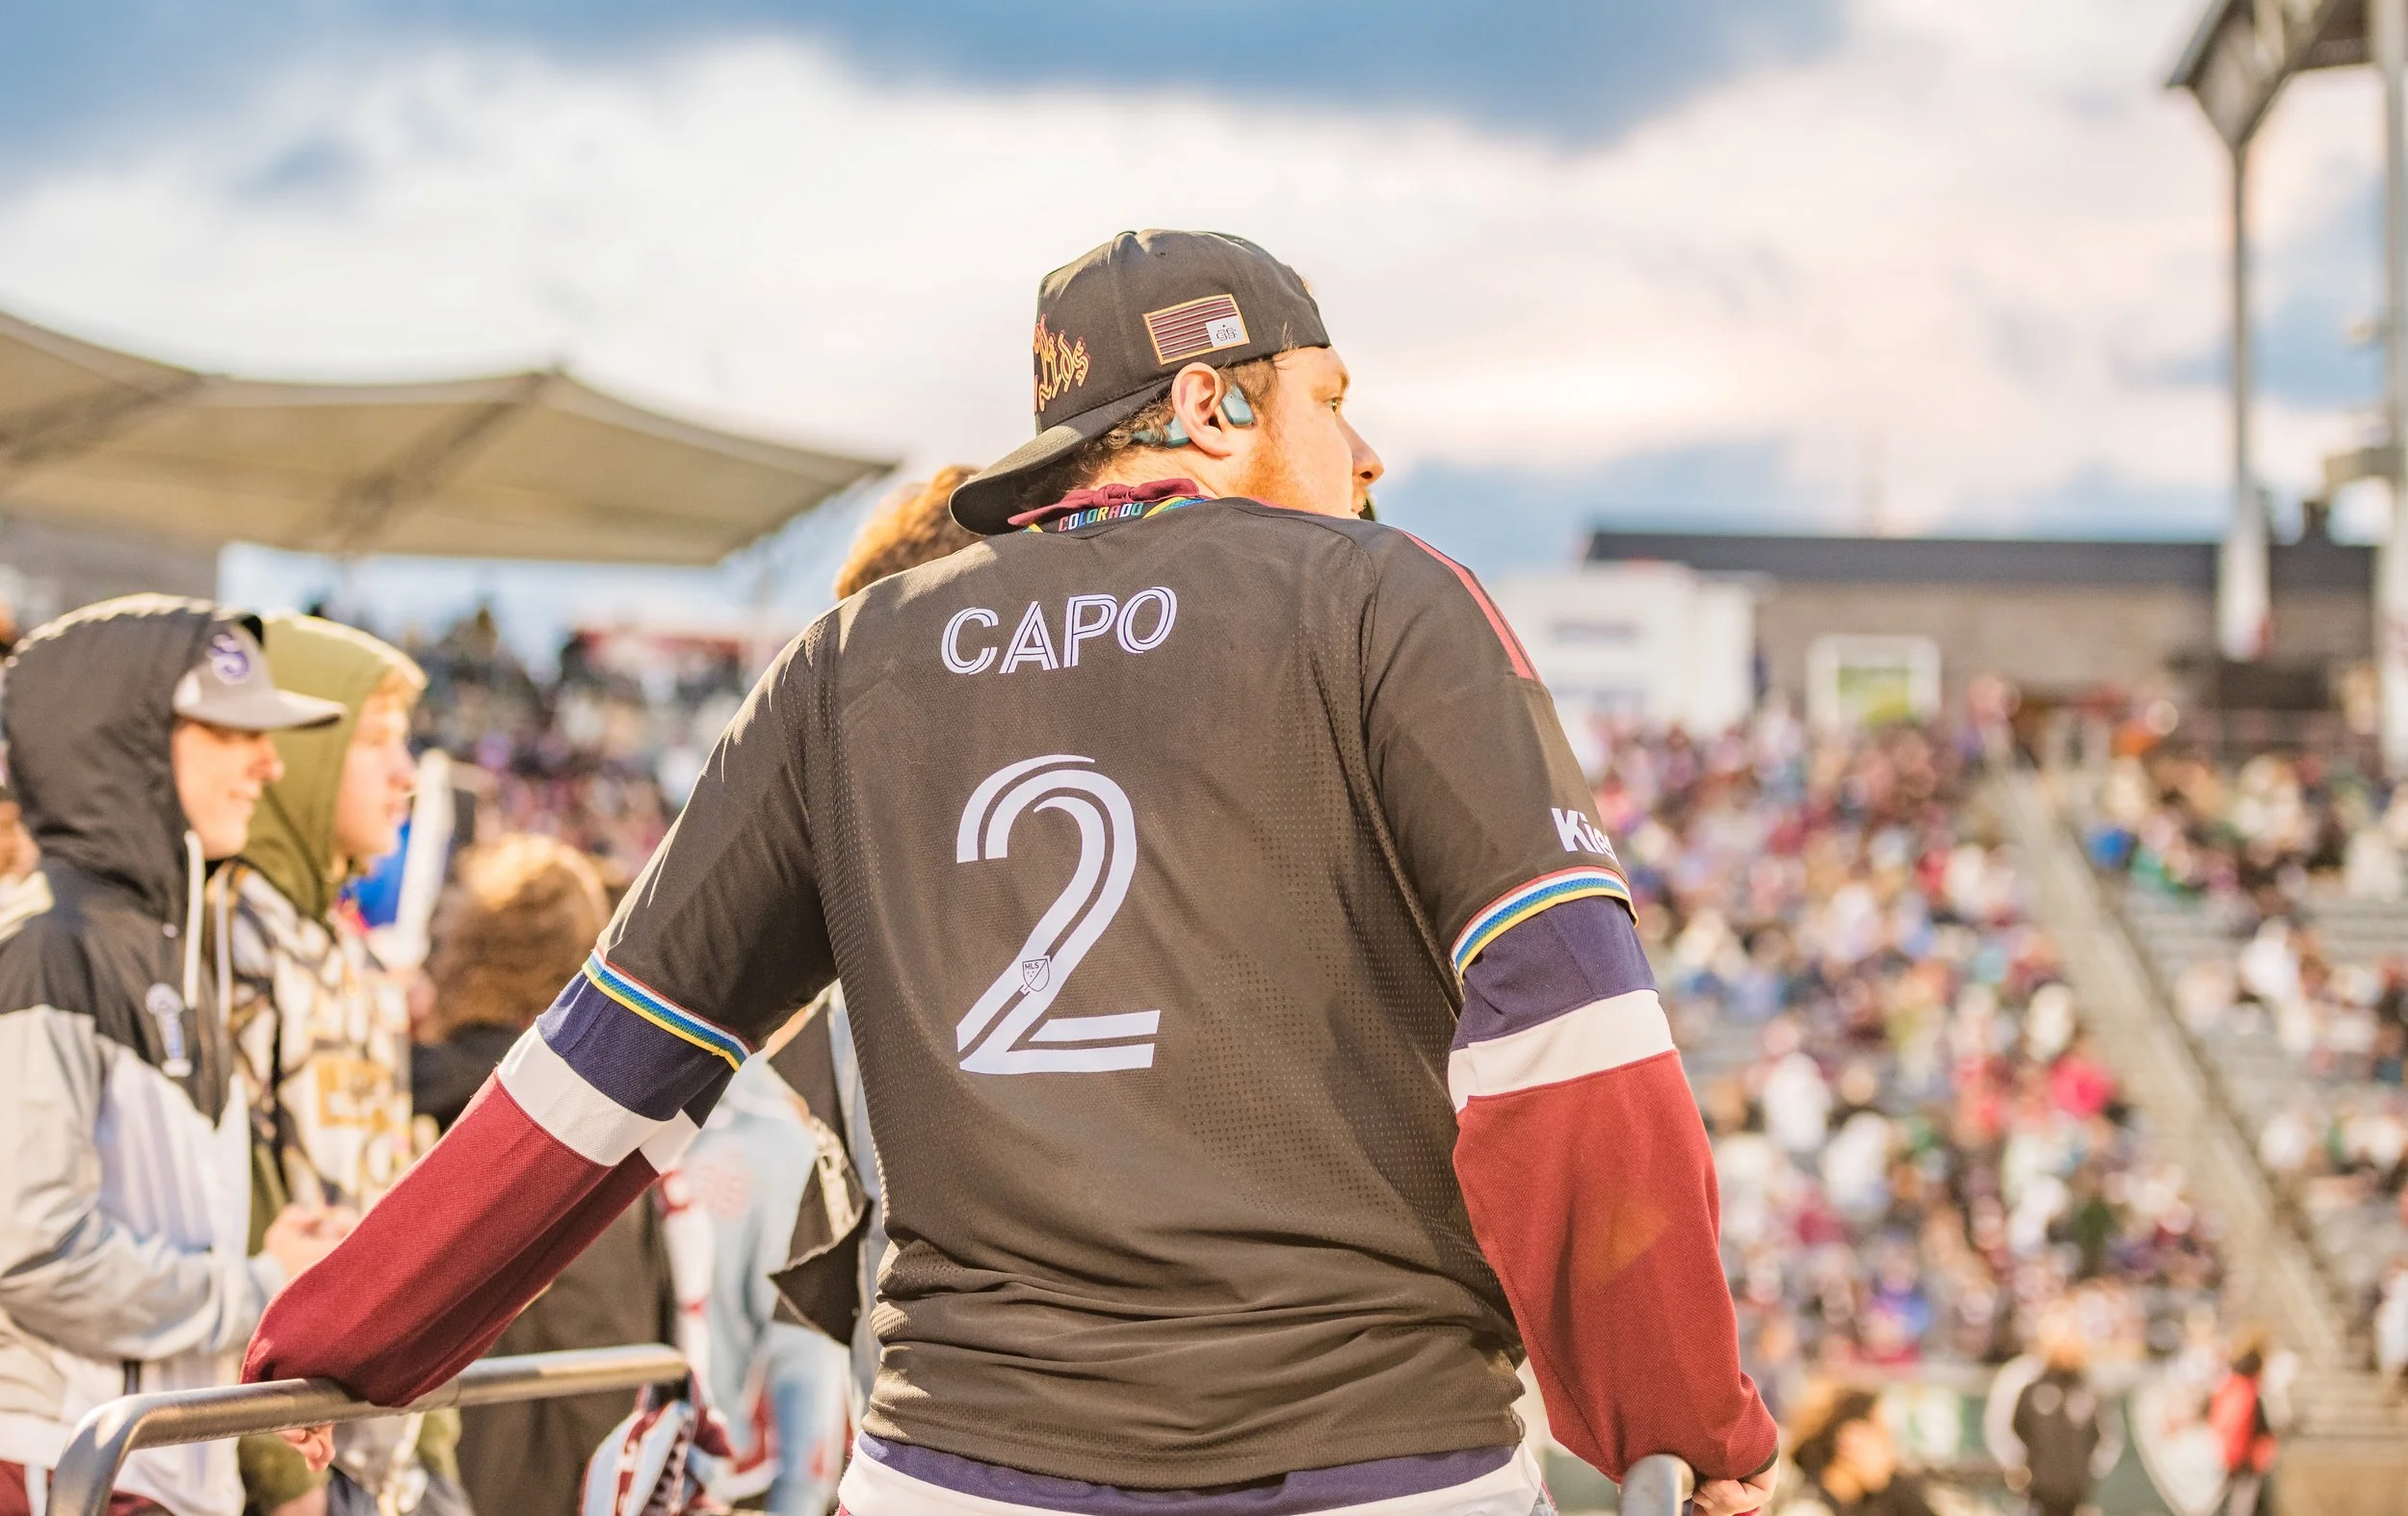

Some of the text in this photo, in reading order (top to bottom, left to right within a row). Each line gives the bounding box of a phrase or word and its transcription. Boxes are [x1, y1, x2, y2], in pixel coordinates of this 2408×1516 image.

[1058, 503, 1145, 533] COLORADO
[940, 586, 1178, 674] CAPO
[955, 754, 1162, 1075] 2
